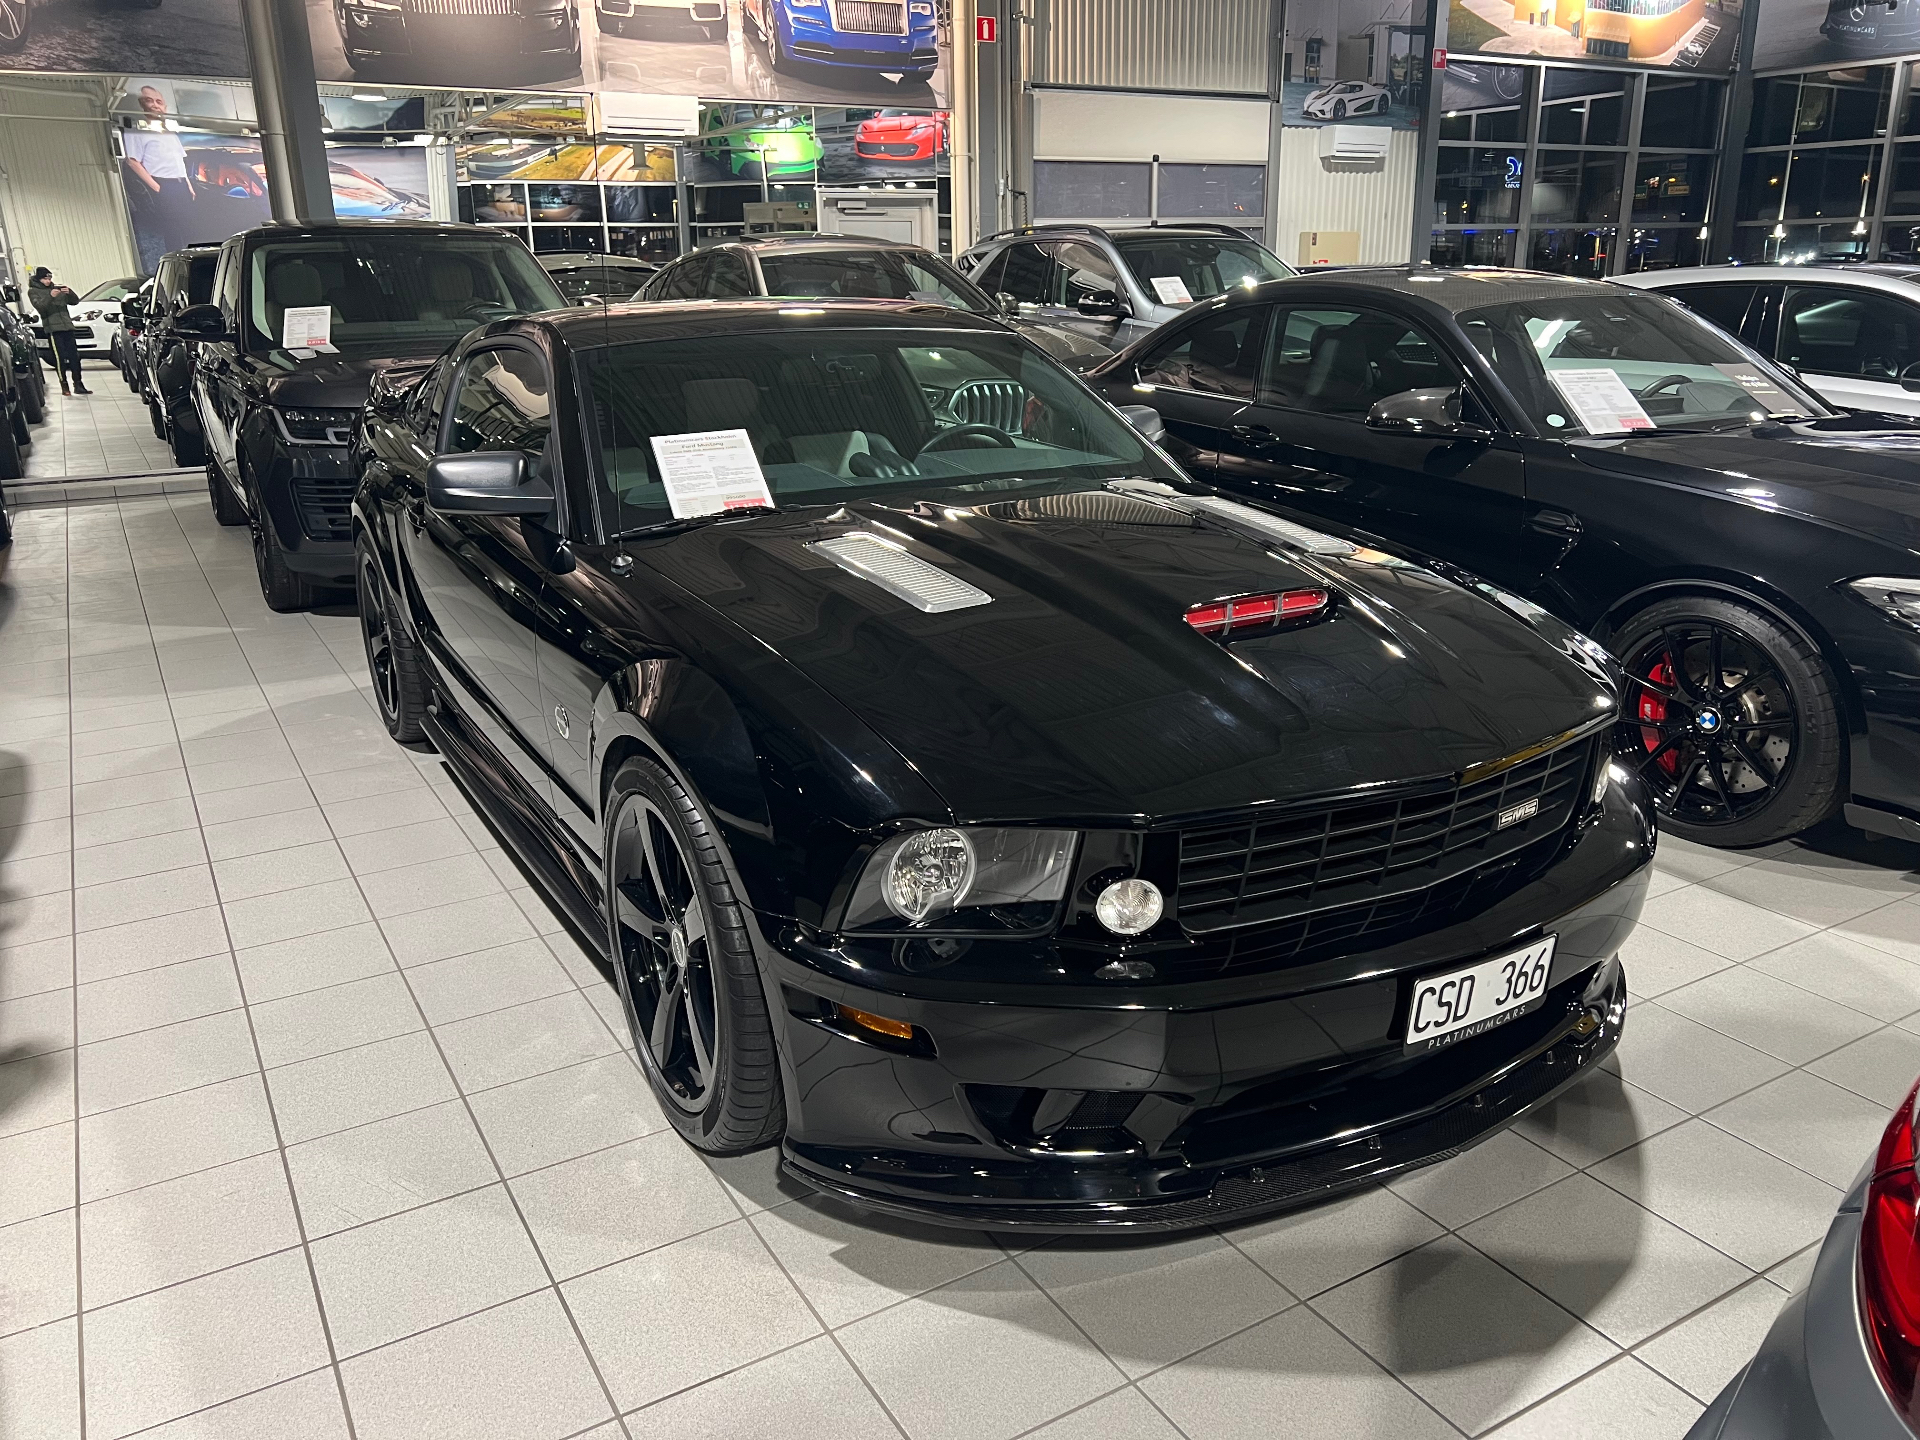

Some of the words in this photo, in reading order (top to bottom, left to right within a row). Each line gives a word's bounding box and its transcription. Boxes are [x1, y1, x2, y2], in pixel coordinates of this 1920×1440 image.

[1413, 974, 1476, 1034] CSD
[1495, 947, 1548, 1006] 366
[1428, 1005, 1526, 1049] PLATINUMCARS
